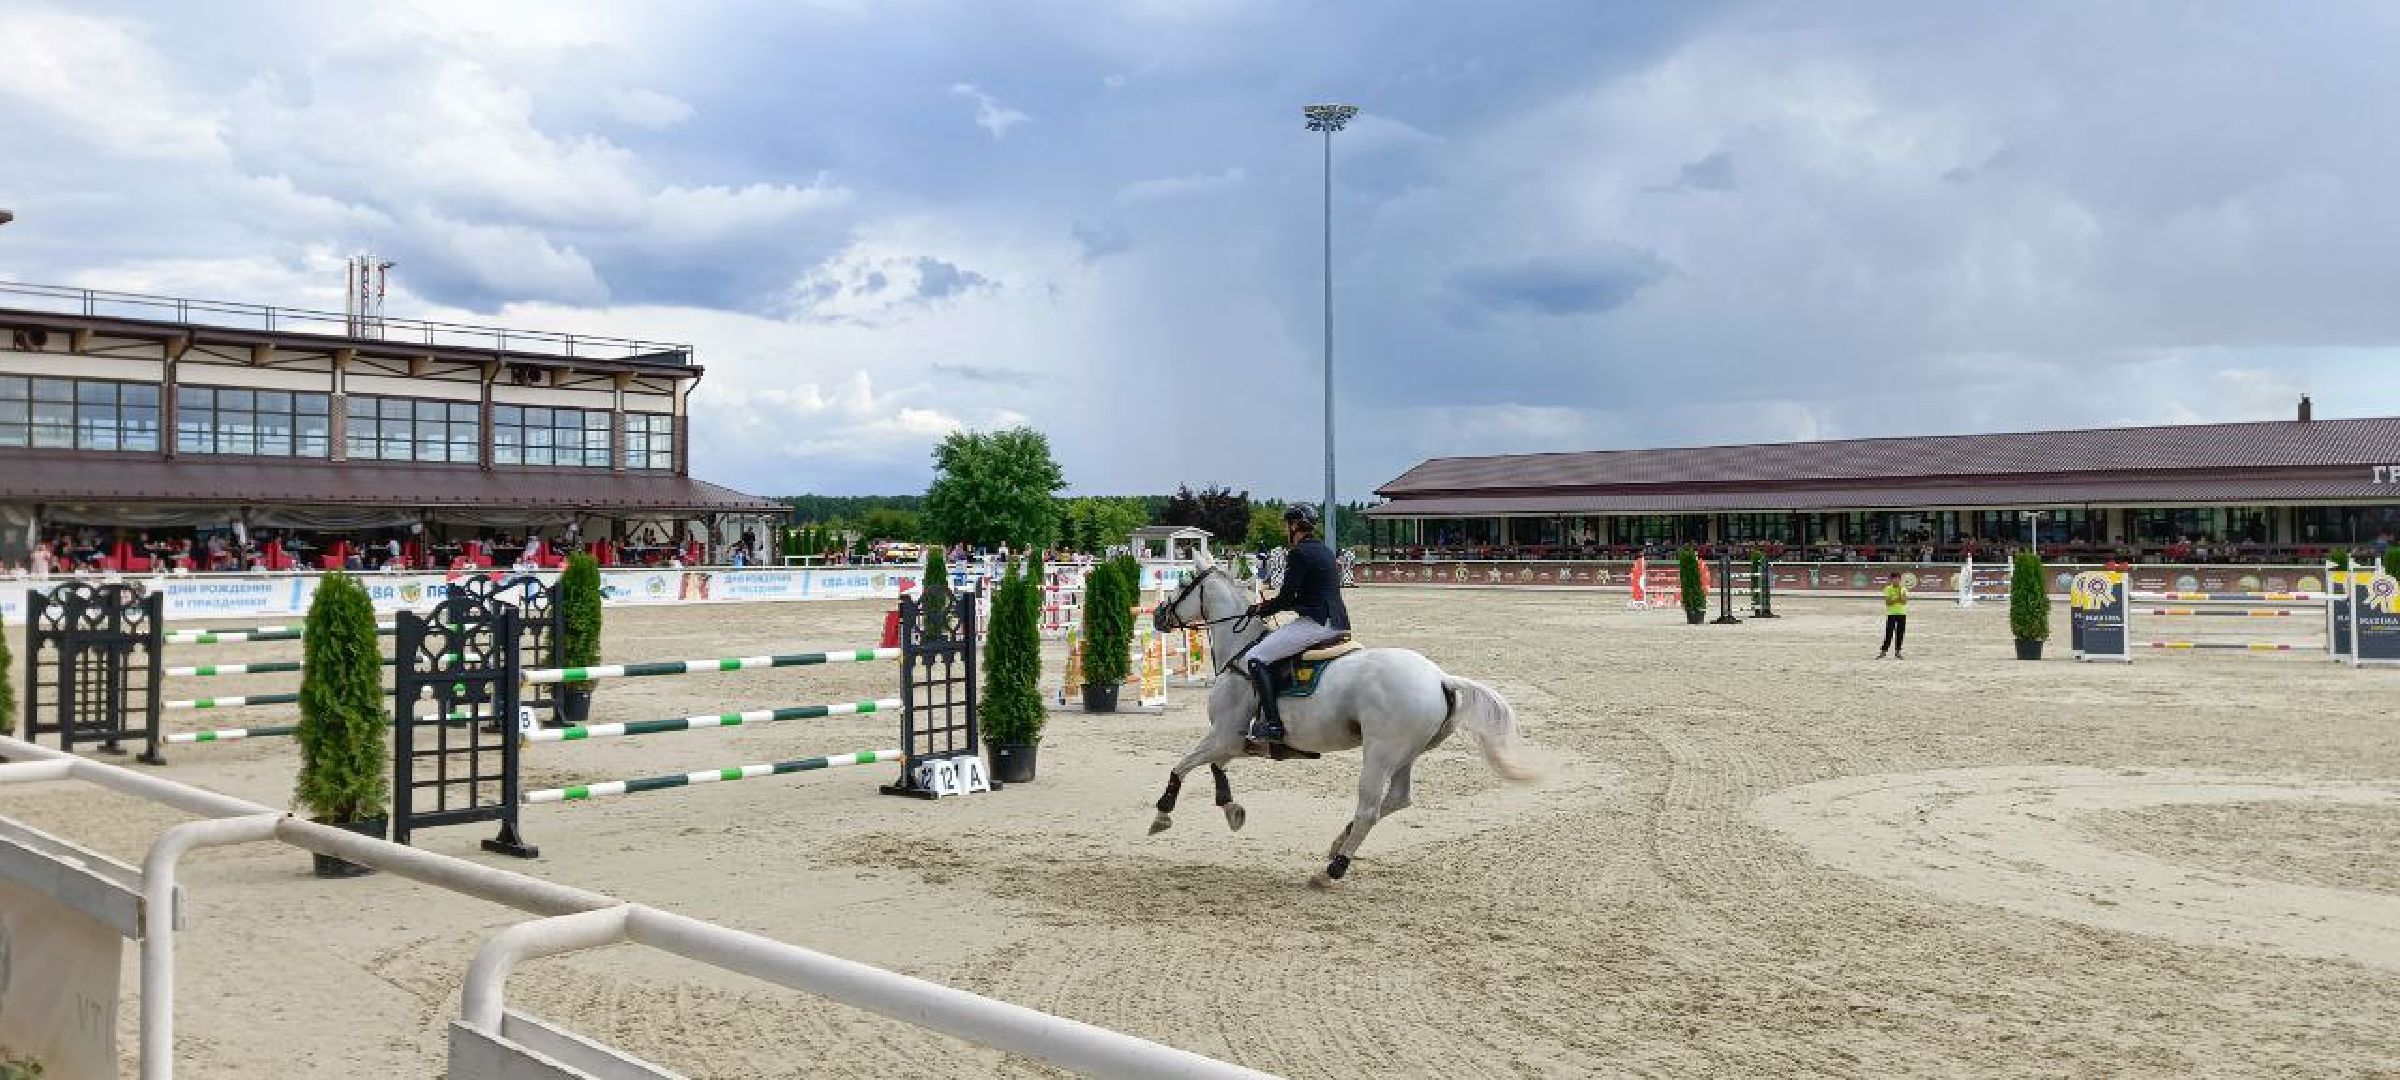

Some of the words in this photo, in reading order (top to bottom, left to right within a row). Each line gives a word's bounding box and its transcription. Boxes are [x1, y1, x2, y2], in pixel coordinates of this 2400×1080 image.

[168, 585, 196, 594] ДНИ
[200, 584, 272, 594] РОЖДЕНИЯ
[427, 585, 449, 597] ПА
[970, 764, 982, 787] A
